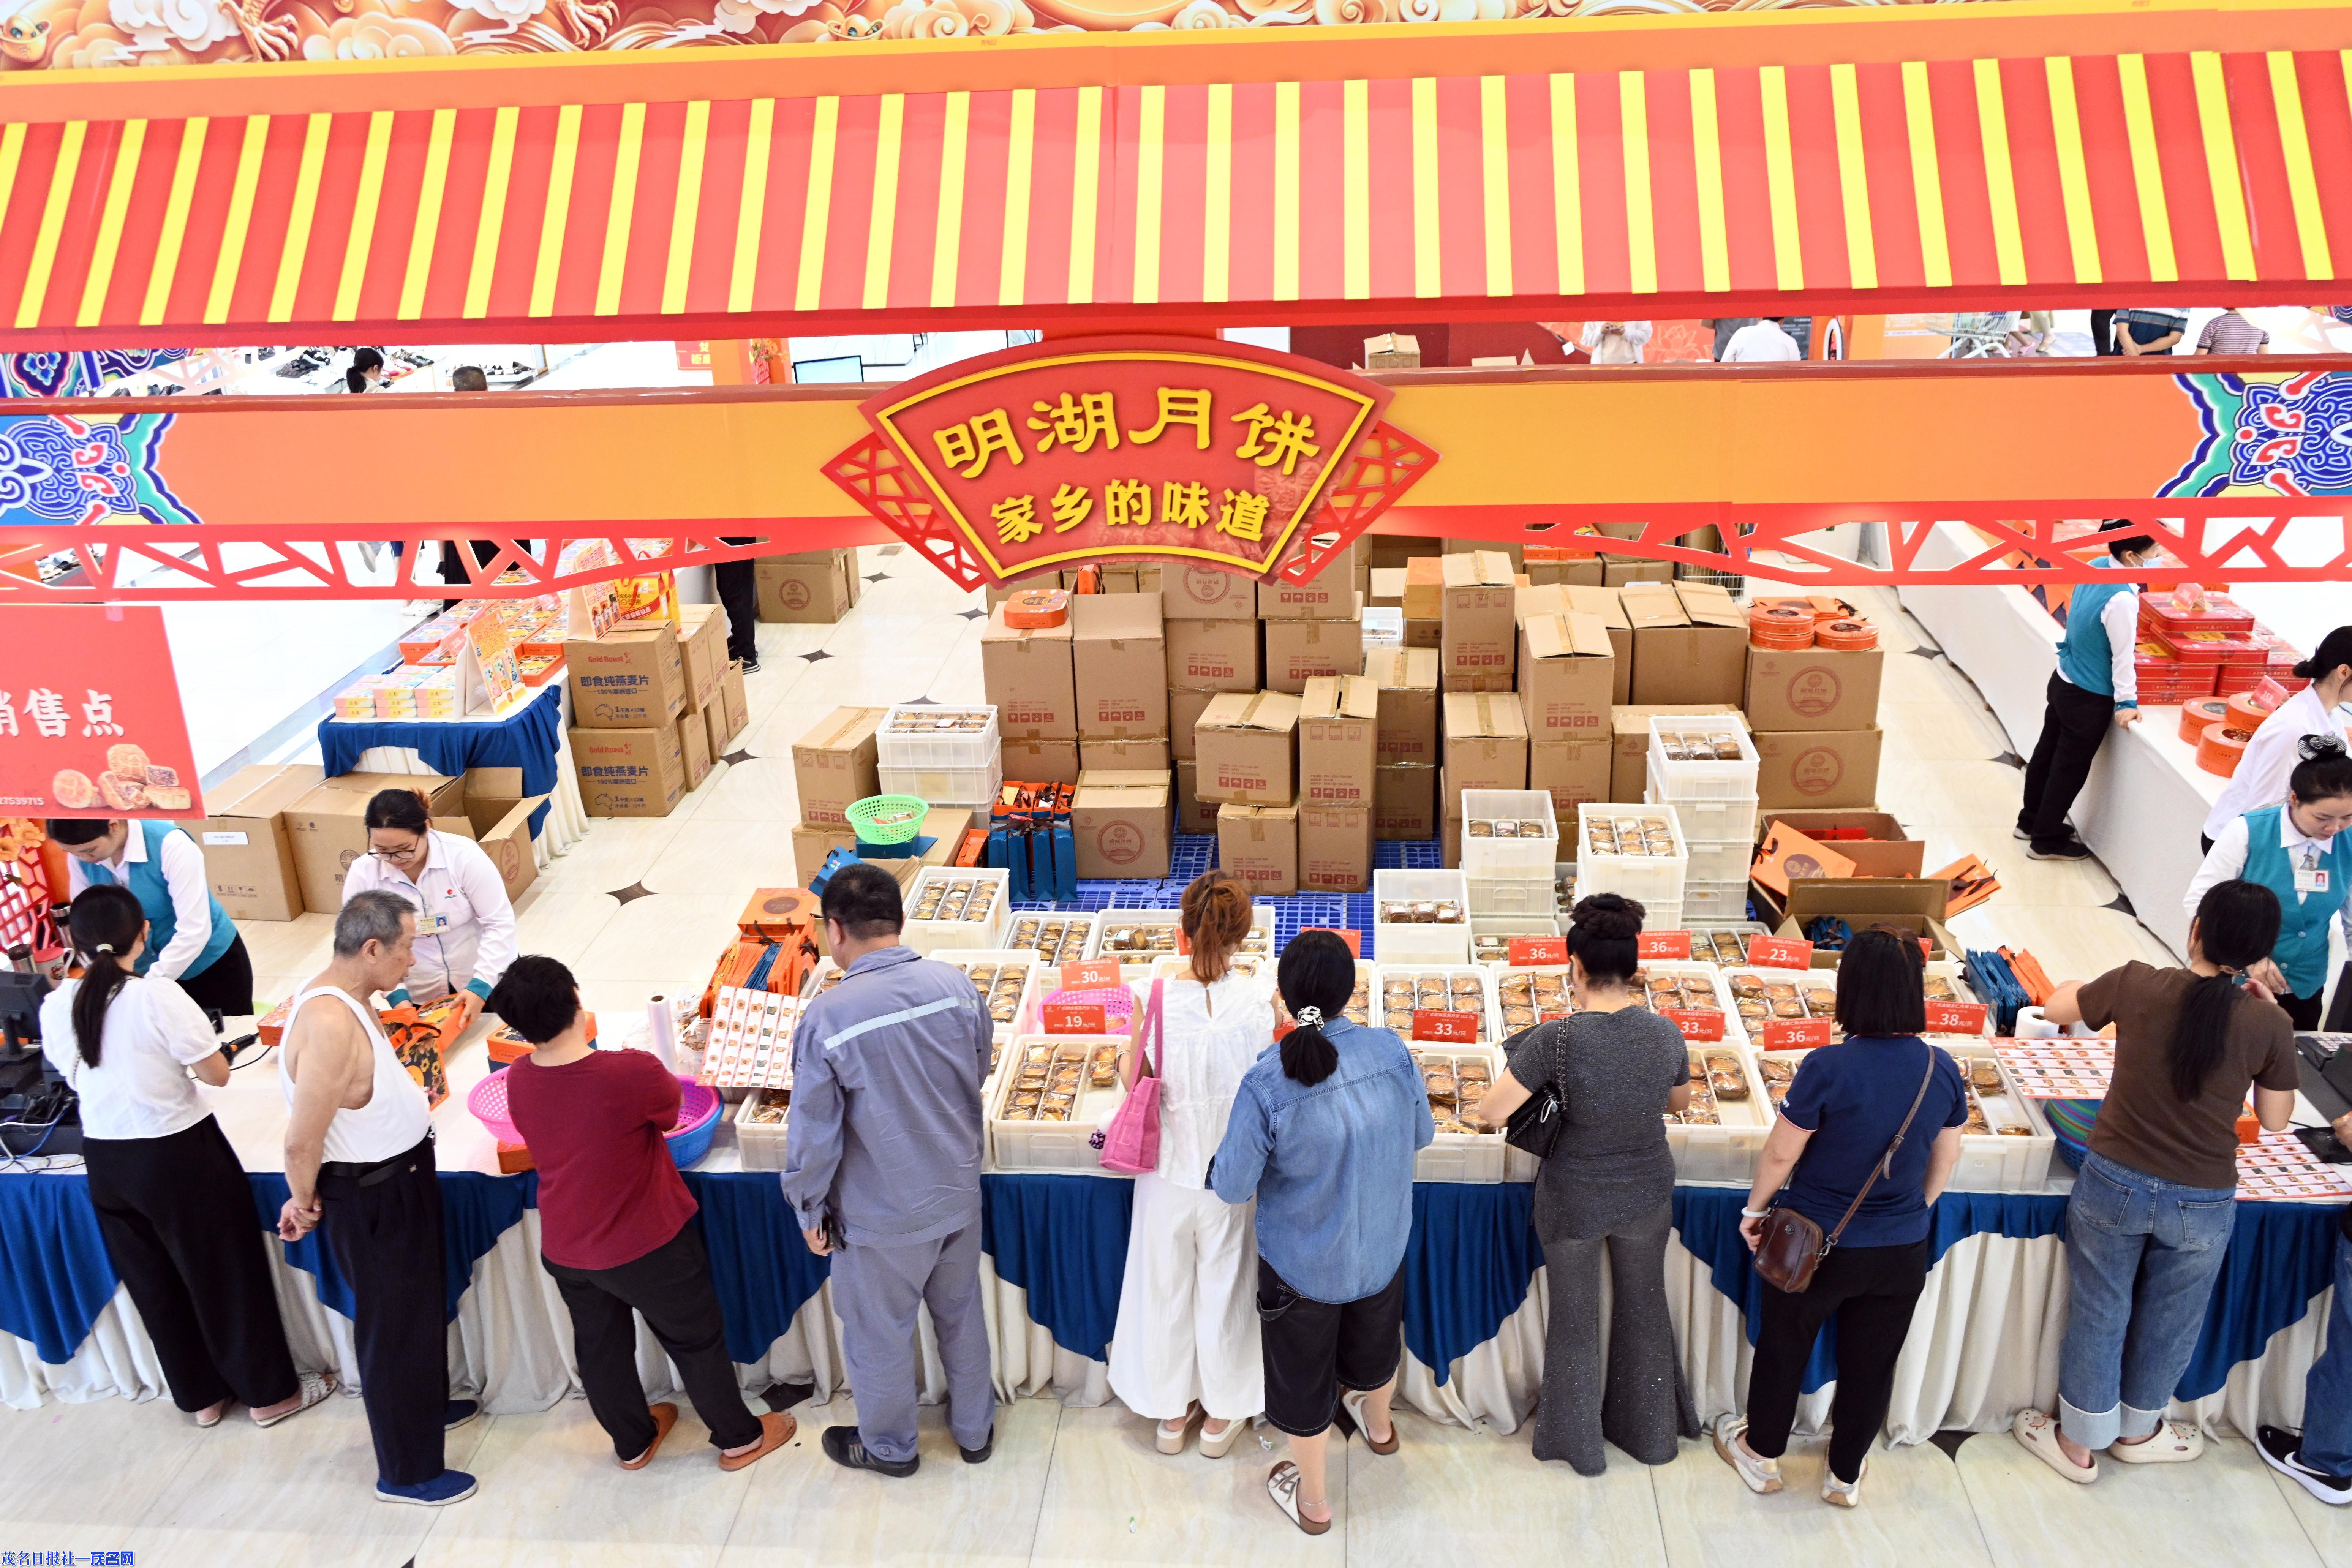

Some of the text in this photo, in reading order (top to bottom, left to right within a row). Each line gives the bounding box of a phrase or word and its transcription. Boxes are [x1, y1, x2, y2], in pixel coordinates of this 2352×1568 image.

[933, 386, 1320, 479] 明湖月饼
[990, 478, 1270, 545] 家乡的味道
[580, 674, 650, 687] 即食纯燕麦片
[581, 765, 649, 777] 即食纯燕麦片
